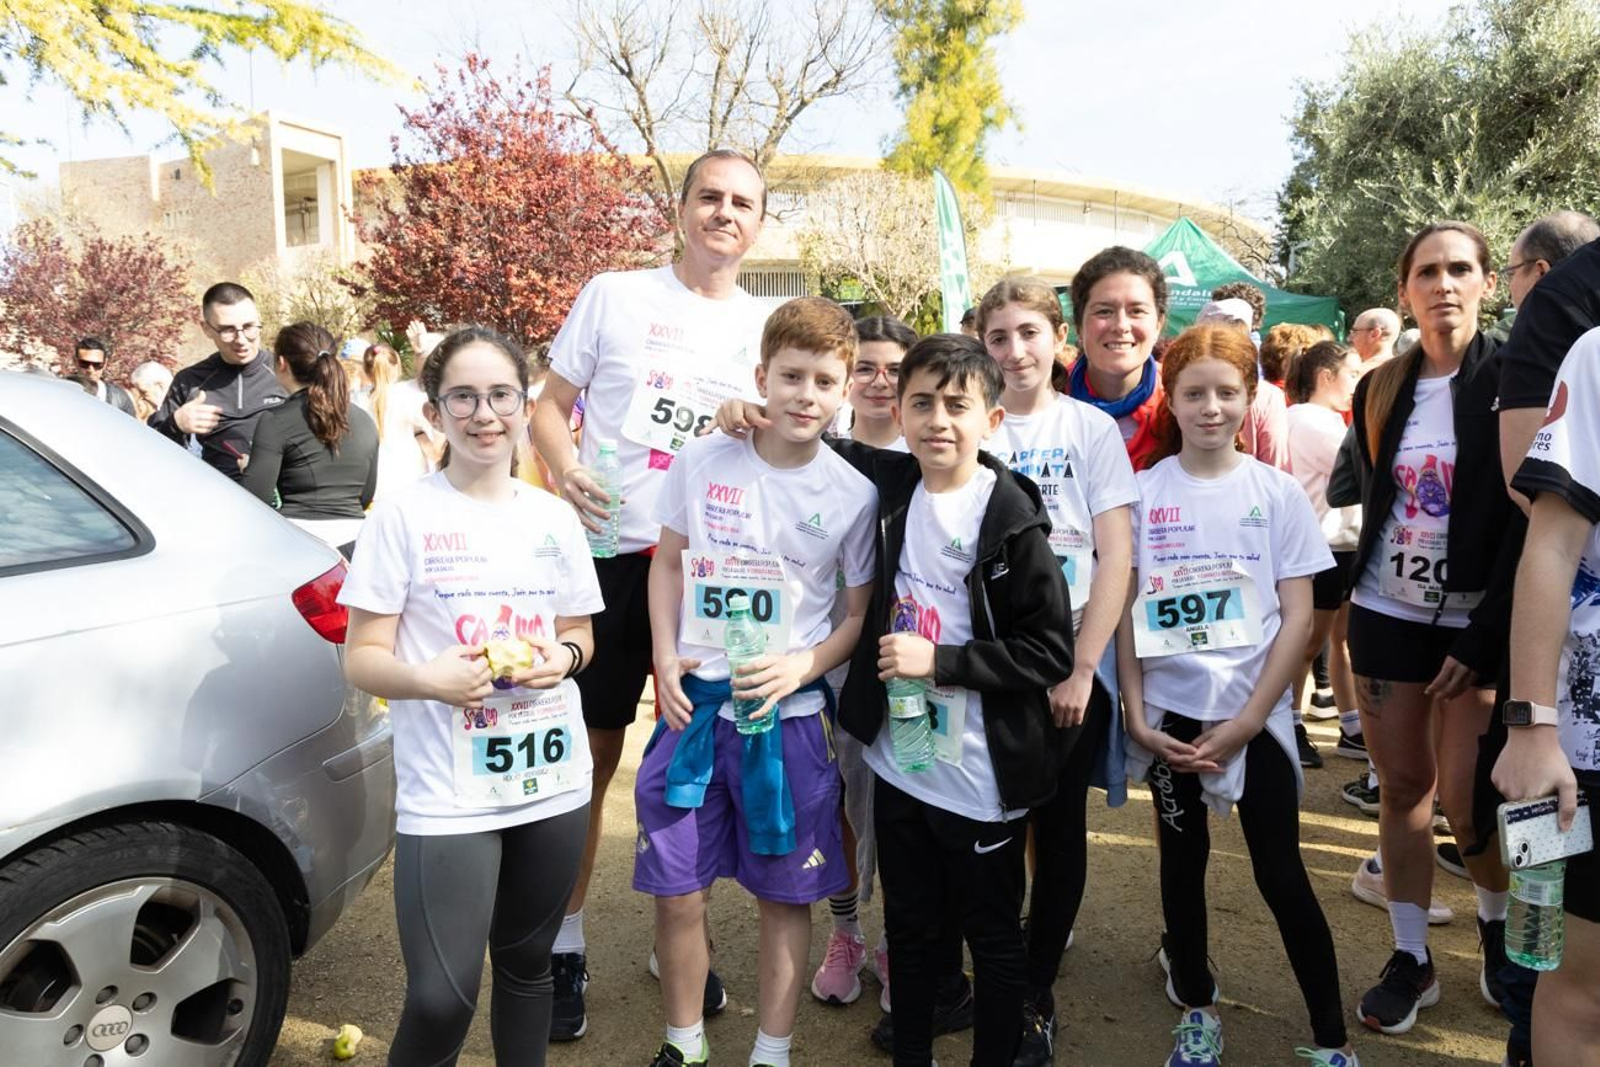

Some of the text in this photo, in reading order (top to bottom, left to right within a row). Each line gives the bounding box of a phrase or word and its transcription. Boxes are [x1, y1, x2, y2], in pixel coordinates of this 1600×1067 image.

[651, 397, 713, 438] 598
[1536, 432, 1552, 442] no
[1533, 441, 1552, 452] res
[1157, 589, 1231, 629] 597
[485, 727, 565, 774] 516
